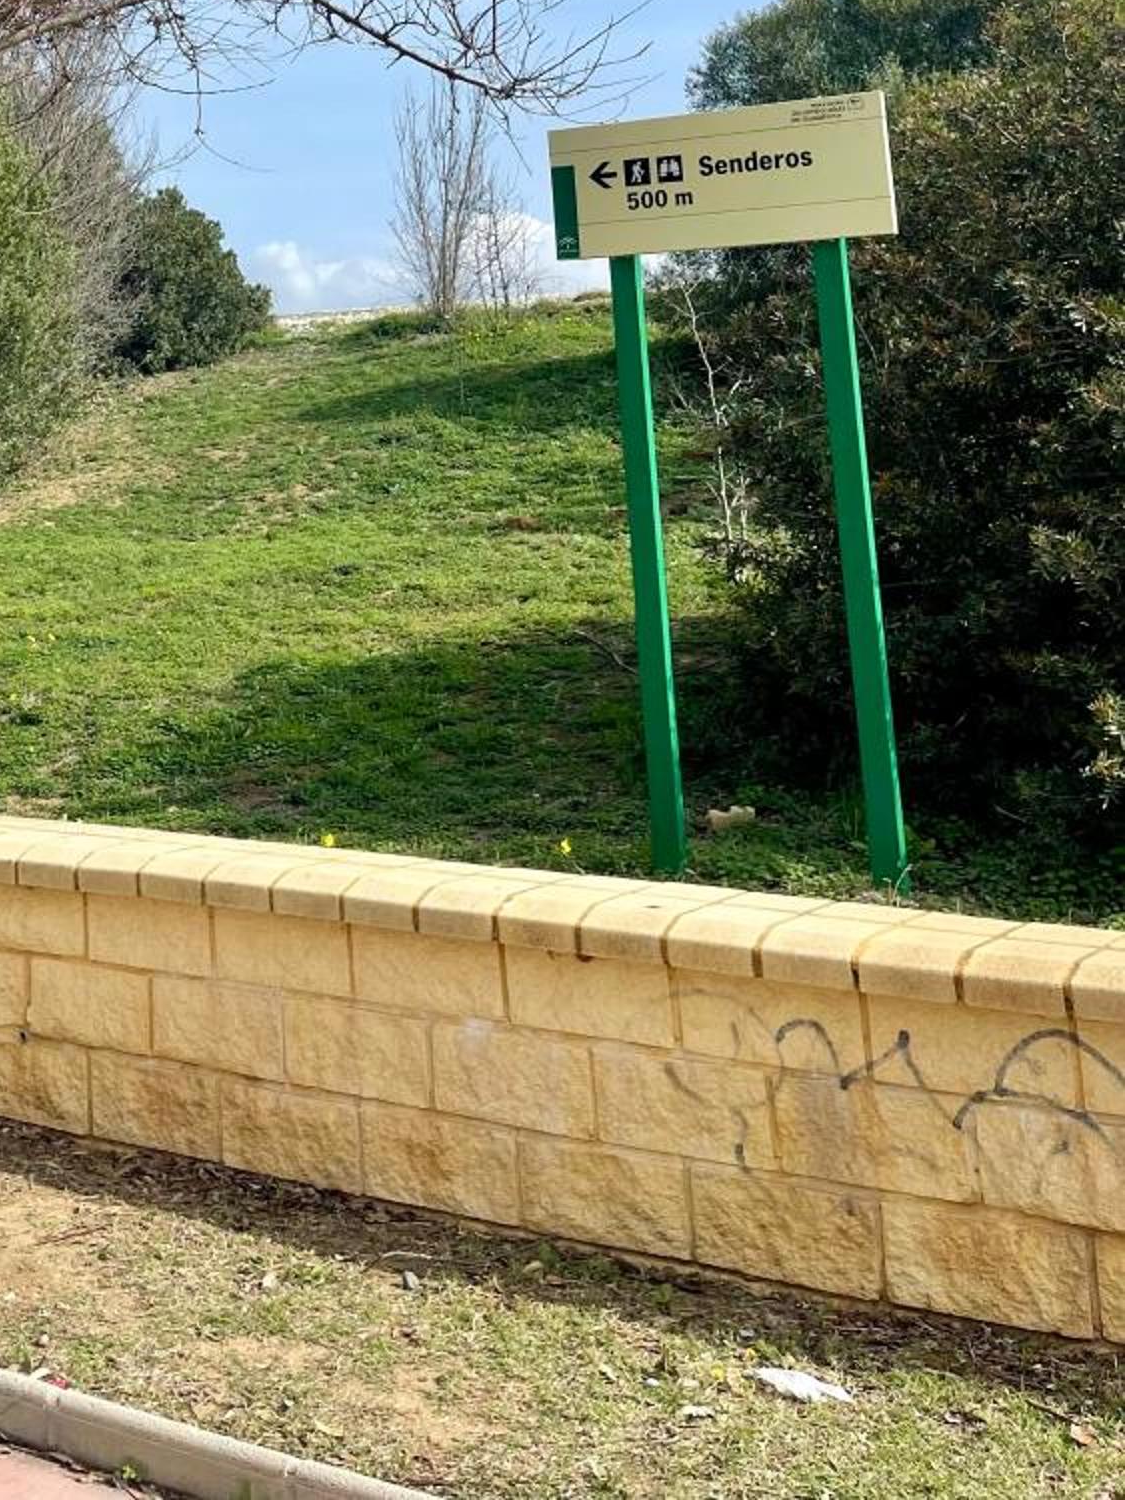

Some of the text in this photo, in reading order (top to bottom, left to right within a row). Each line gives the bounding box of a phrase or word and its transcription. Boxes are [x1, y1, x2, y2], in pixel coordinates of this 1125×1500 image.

[698, 149, 813, 177] Senderos
[626, 189, 693, 210] 500 m
